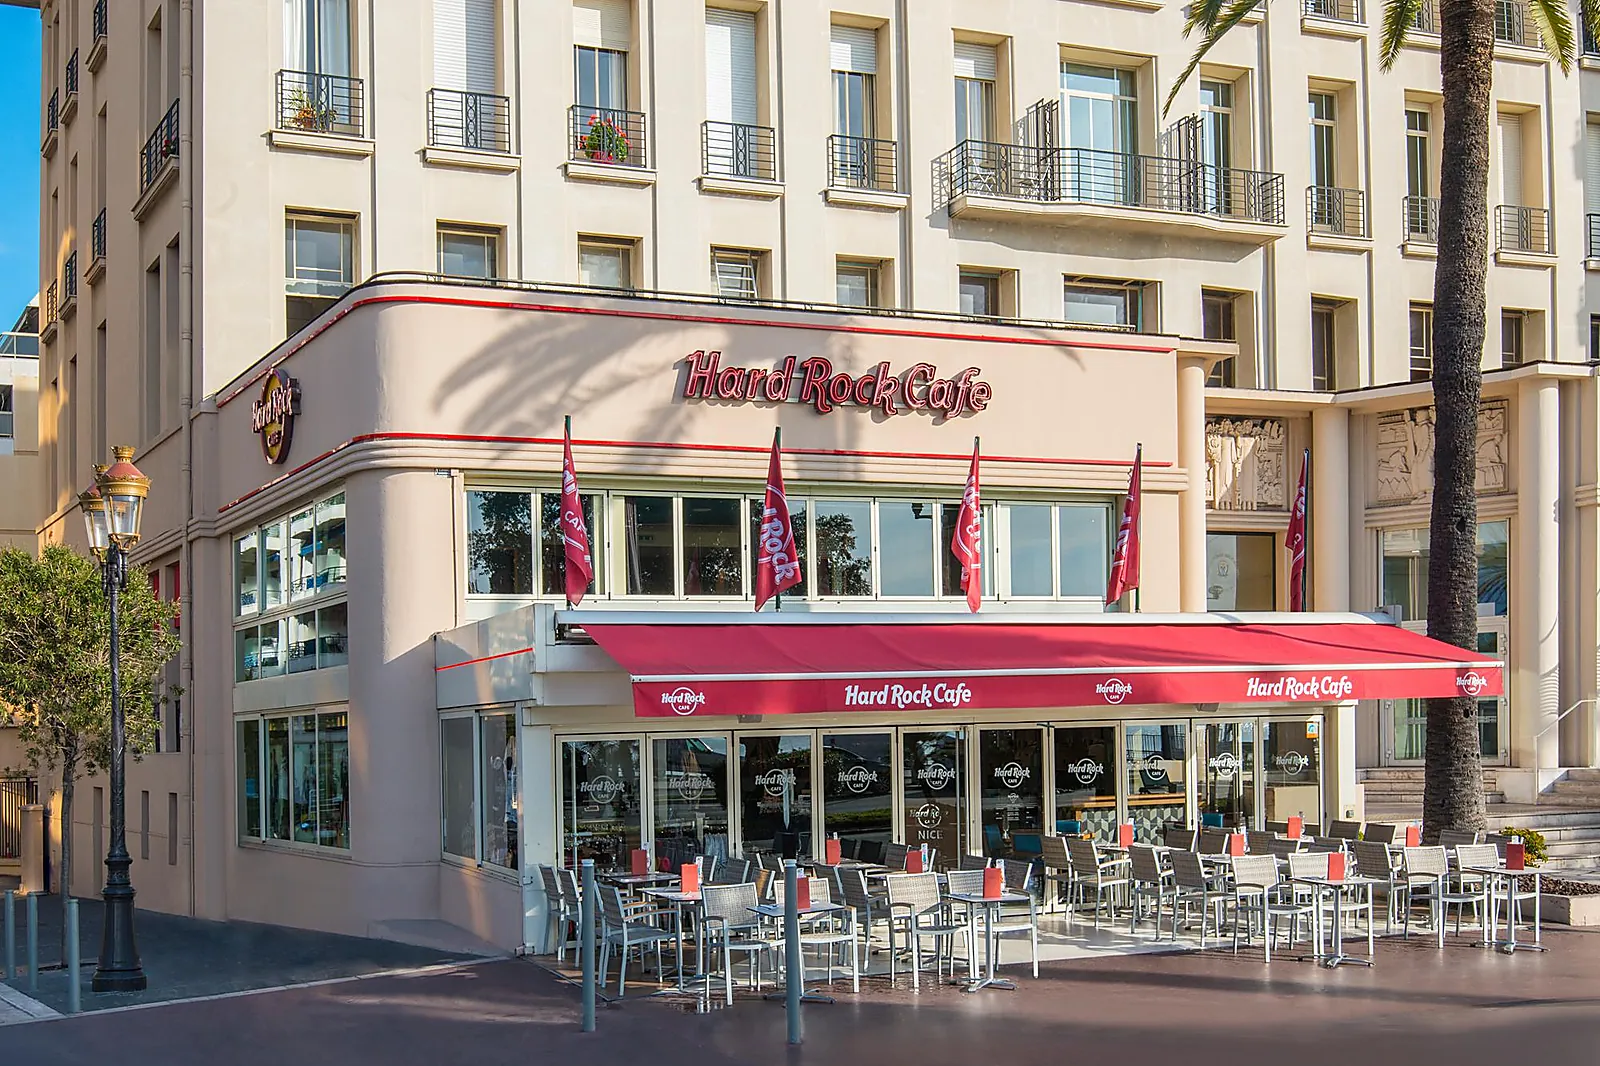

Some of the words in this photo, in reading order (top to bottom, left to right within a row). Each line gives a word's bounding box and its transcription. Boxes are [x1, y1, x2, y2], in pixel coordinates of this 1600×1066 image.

[683, 350, 797, 400] Hard
[800, 356, 900, 416] Rock
[901, 362, 992, 419] Cafe
[1246, 677, 1285, 697] Hard
[1285, 676, 1320, 700] Rock
[1320, 675, 1353, 699] Cafe
[1456, 676, 1472, 686] Hard
[1472, 676, 1488, 687] Rock
[1095, 683, 1115, 694] Hard
[1115, 682, 1132, 694] Rock
[661, 692, 684, 703] Hard
[684, 691, 706, 704] Rock
[844, 684, 889, 706] Hard
[890, 683, 933, 709] Rock
[933, 682, 972, 707] Cafe
[1275, 755, 1292, 765] Hard
[917, 768, 937, 779] Hard
[937, 768, 956, 779] Rock
[994, 767, 1013, 777] Hard
[1013, 766, 1031, 779] Rock
[1067, 763, 1086, 773] Hard
[1086, 762, 1104, 774] Rock
[838, 771, 858, 781] Hard
[858, 770, 878, 783] Rock
[580, 781, 603, 792] Hard
[603, 780, 625, 792] Rock
[918, 830, 944, 840] NICE
